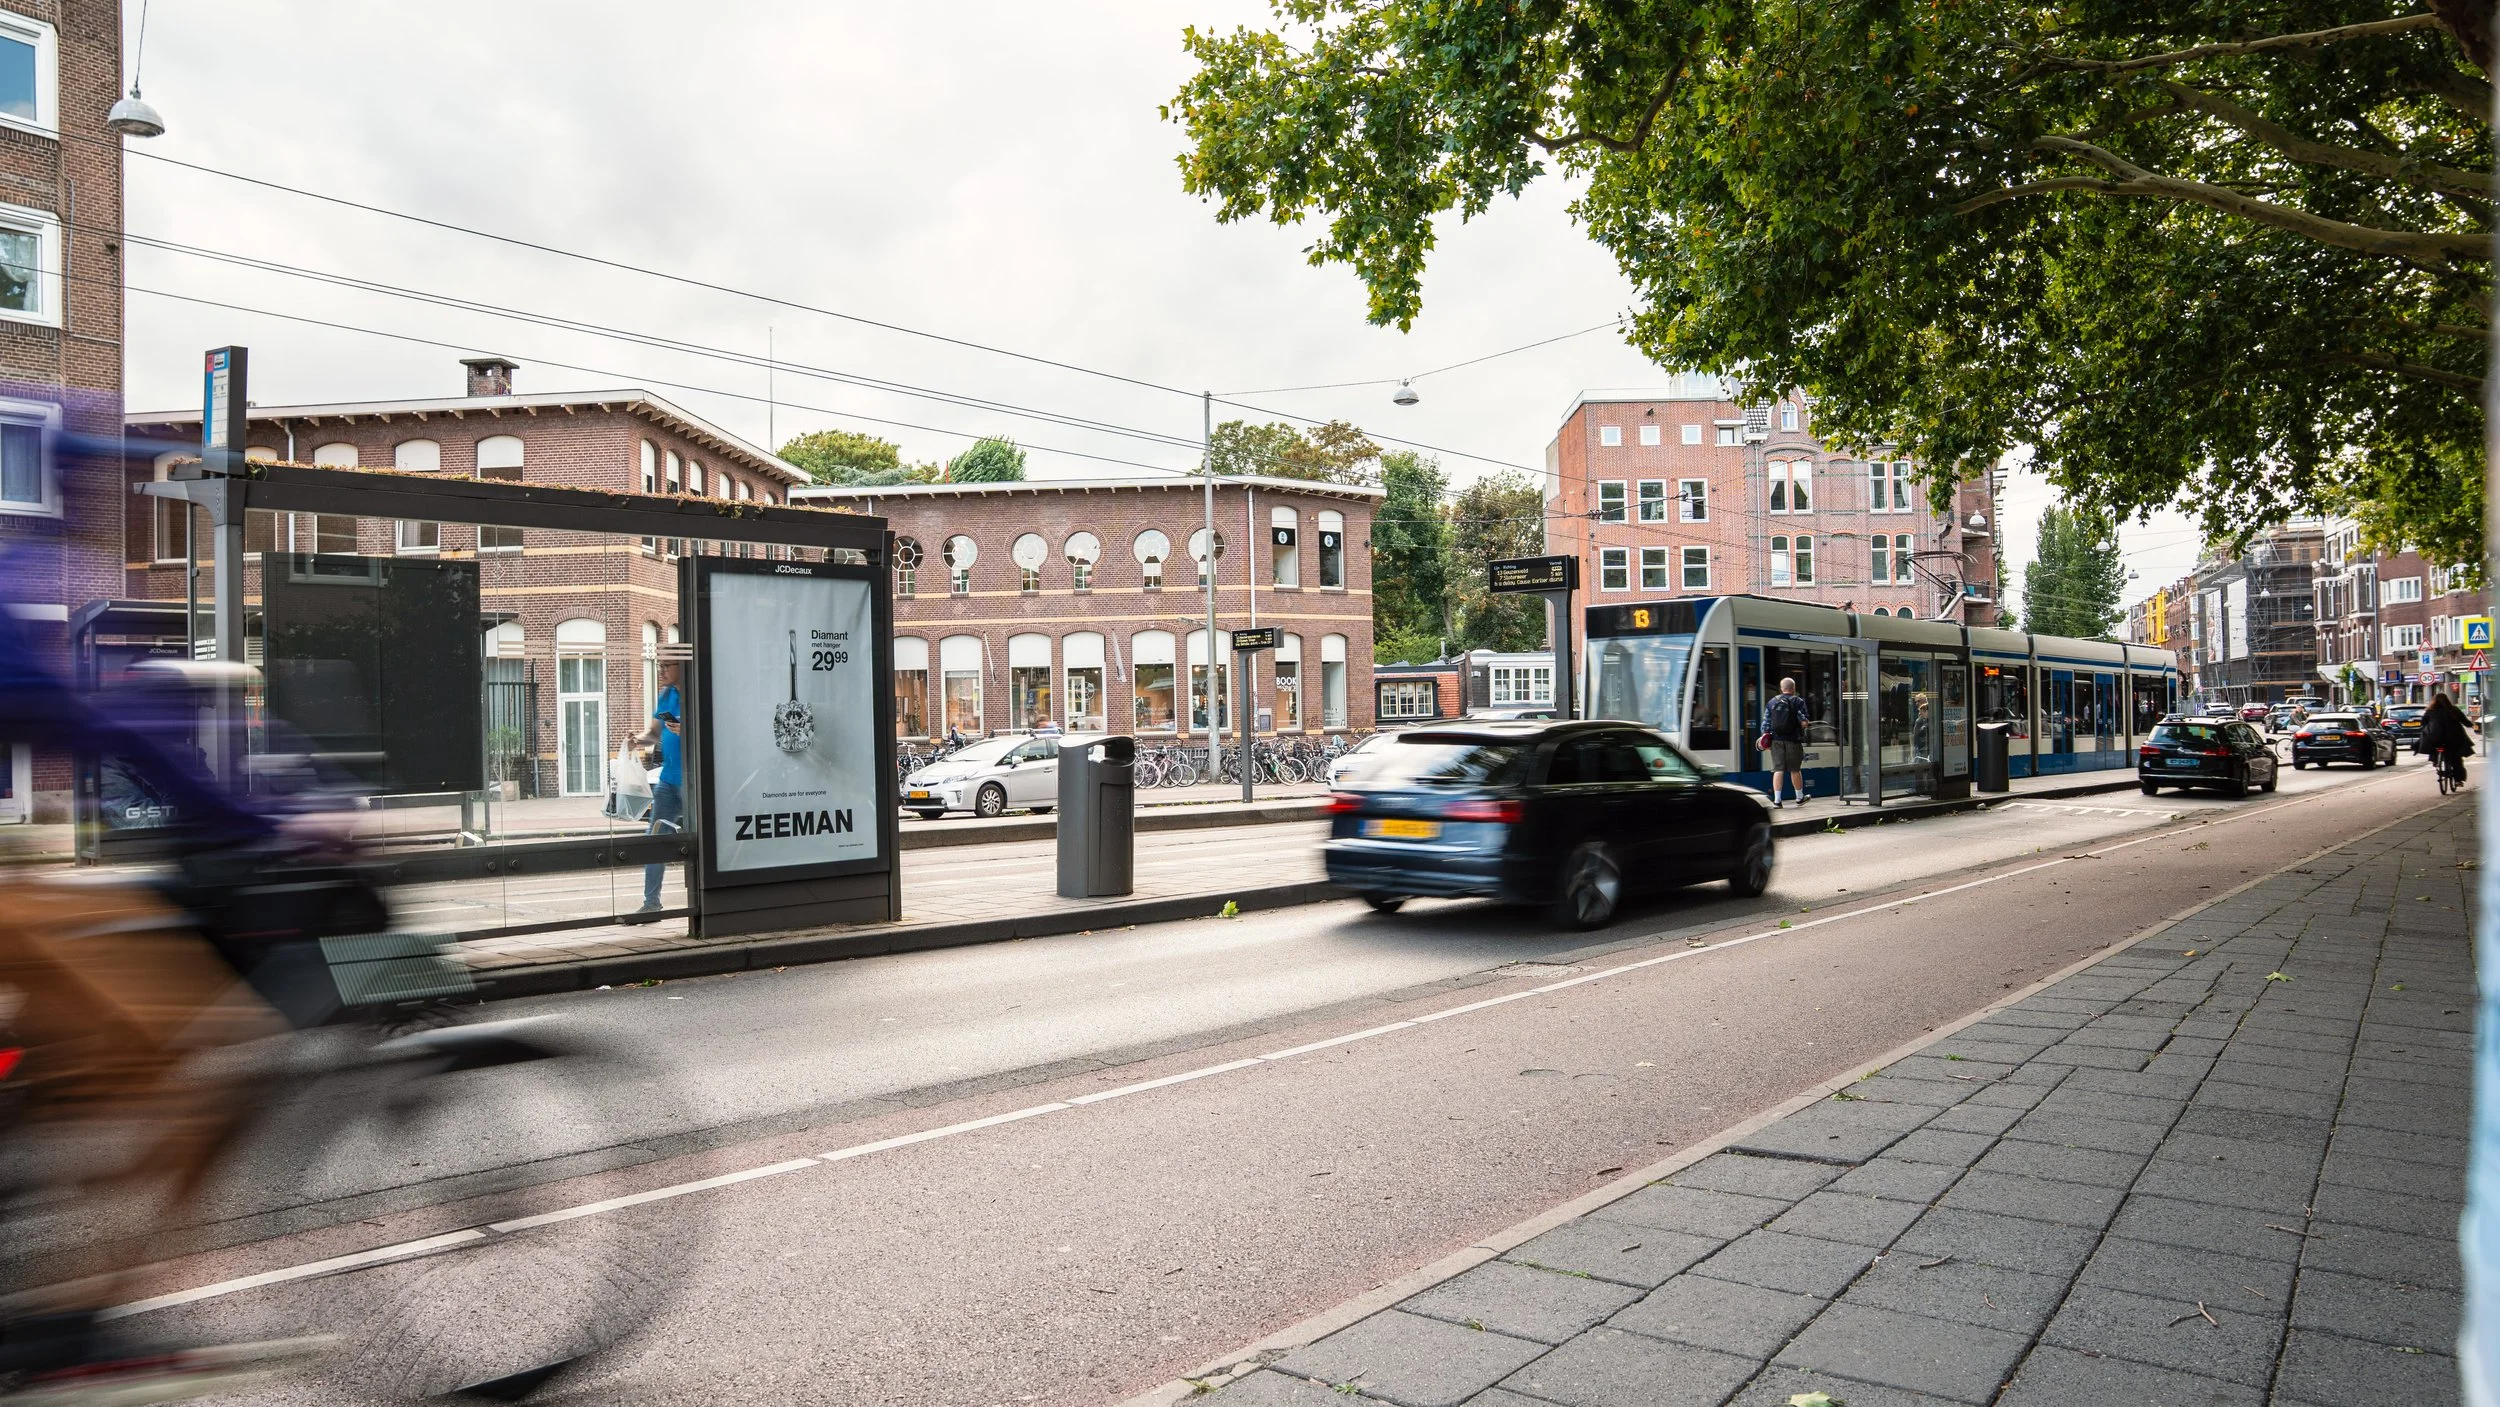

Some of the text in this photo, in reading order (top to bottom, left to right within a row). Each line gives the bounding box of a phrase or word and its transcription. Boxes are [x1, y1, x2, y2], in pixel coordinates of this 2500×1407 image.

[775, 565, 812, 575] JCDecaux
[1633, 609, 1650, 628] 13
[811, 629, 848, 640] Diamant
[823, 642, 841, 650] hanger
[126, 805, 178, 819] G-ST
[735, 808, 853, 841] ZEEMAN
